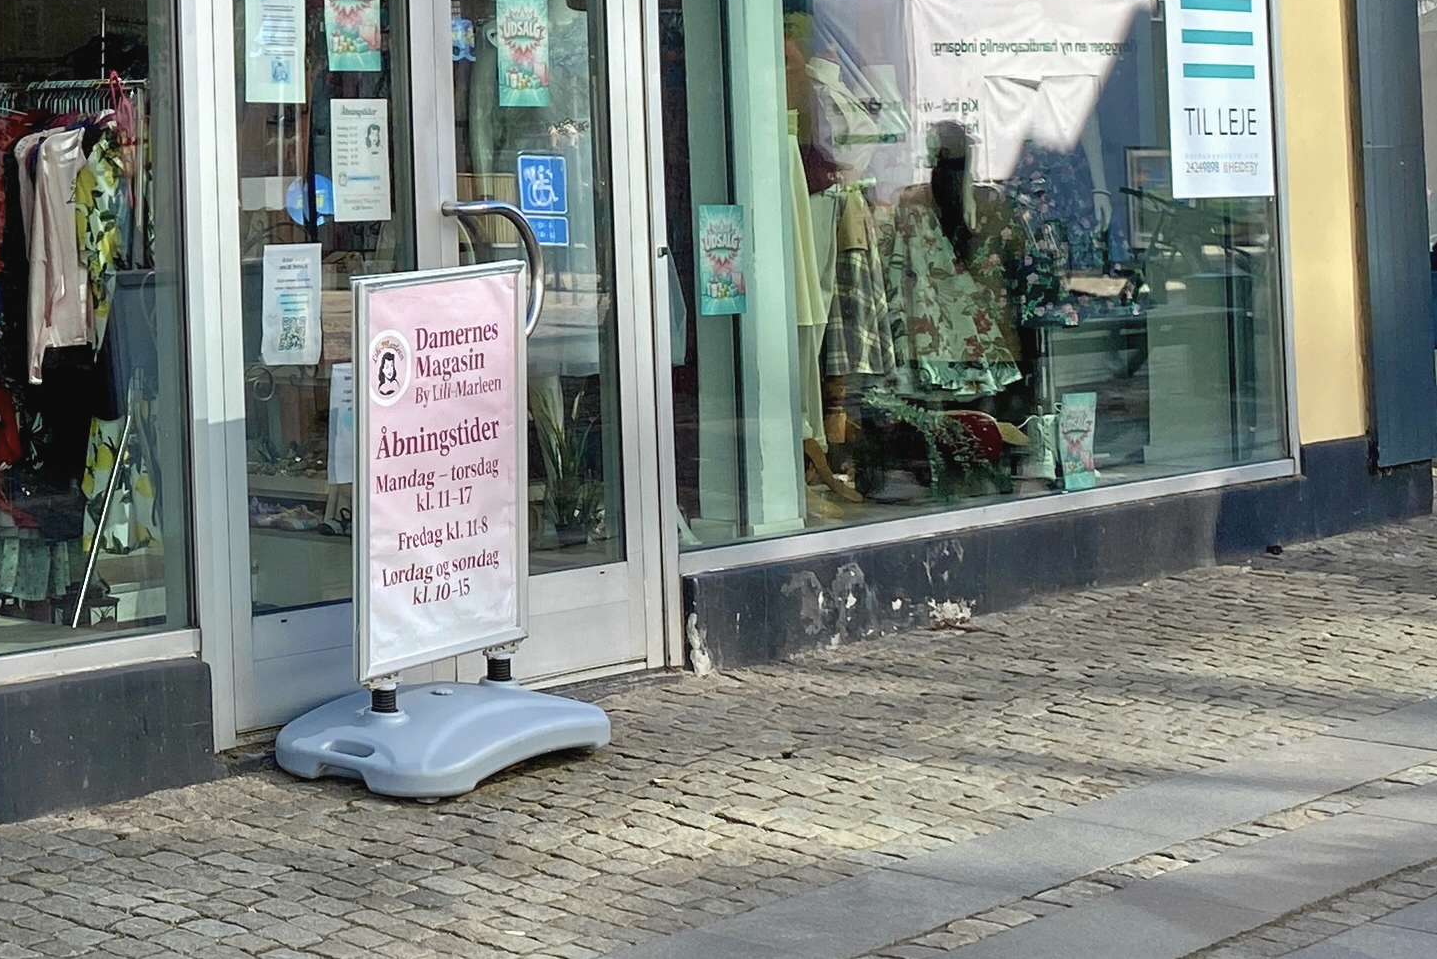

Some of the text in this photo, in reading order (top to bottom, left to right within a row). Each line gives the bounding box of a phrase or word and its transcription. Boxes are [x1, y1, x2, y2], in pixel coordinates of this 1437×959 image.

[502, 19, 541, 39] UDSALG
[1183, 107, 1257, 136] TIL LEJE
[705, 233, 739, 250] UDSALG
[414, 322, 499, 351] Damernes
[415, 347, 485, 381] Magasin
[415, 375, 502, 408] By Lili-Marleen
[375, 416, 500, 460] Åbningstider
[375, 468, 436, 494] Mandag
[451, 456, 499, 482] torsdag
[416, 491, 435, 513] kl.
[397, 525, 443, 551] Fredag
[446, 520, 464, 541] kl.
[435, 560, 451, 581] og
[451, 548, 500, 573] søndag
[412, 585, 432, 606] kl.
